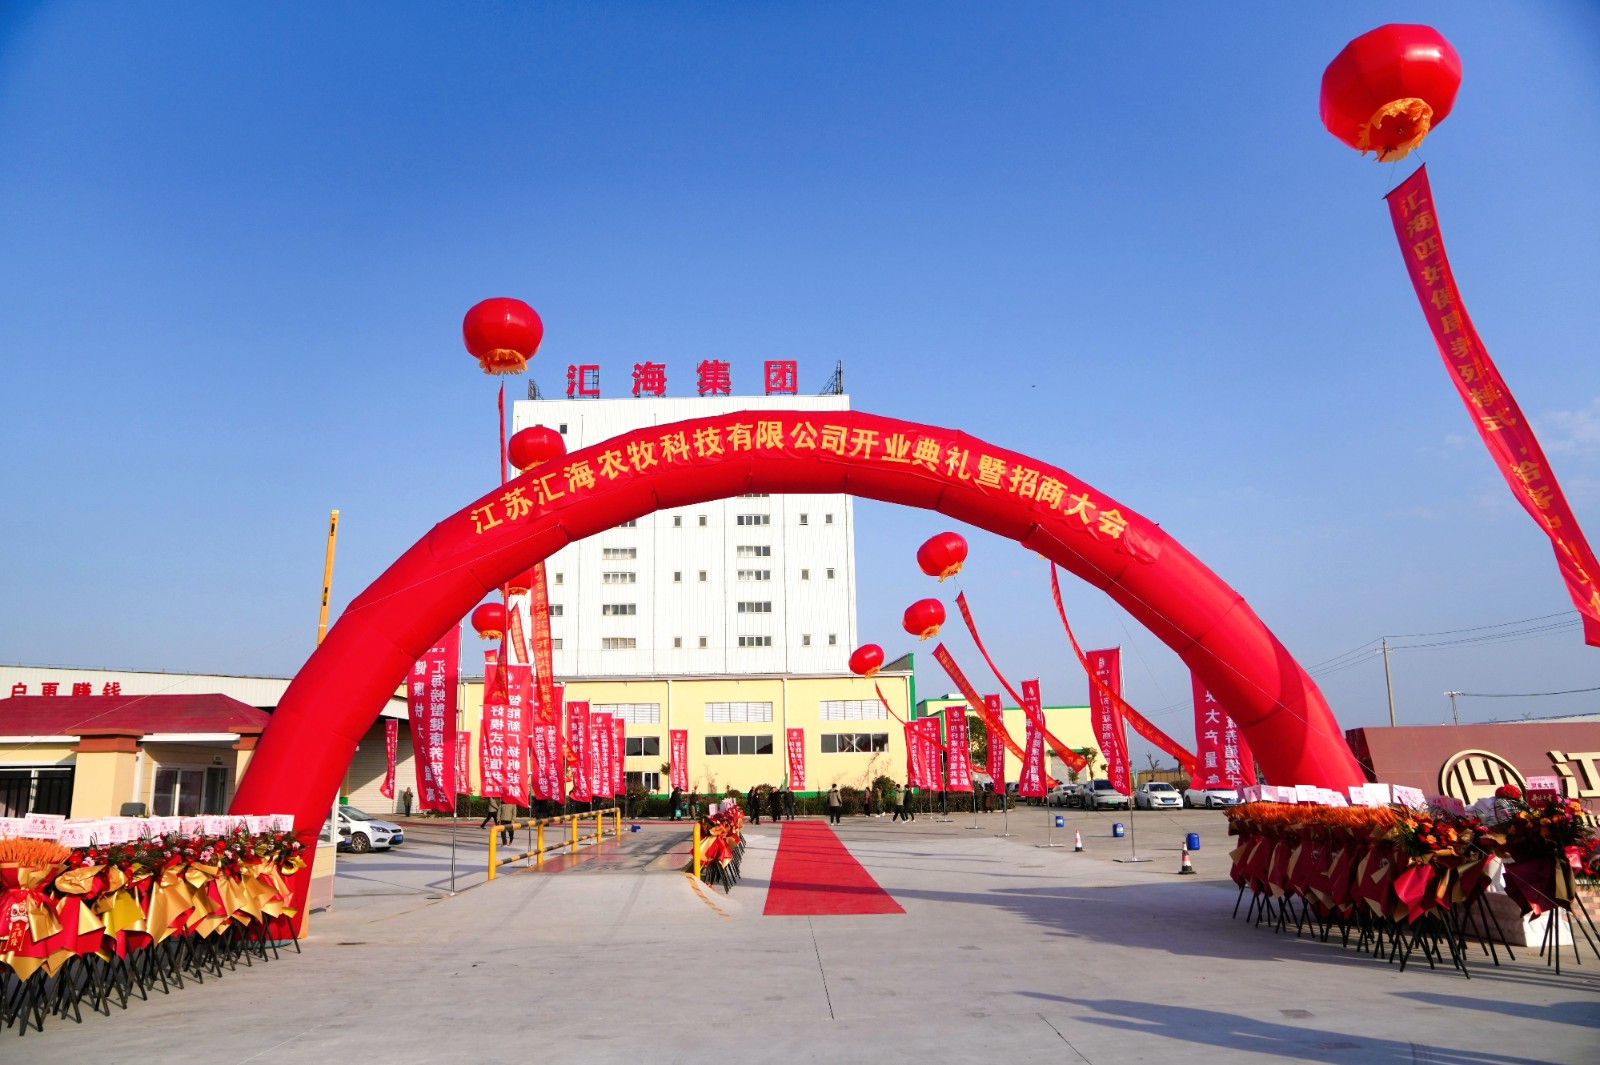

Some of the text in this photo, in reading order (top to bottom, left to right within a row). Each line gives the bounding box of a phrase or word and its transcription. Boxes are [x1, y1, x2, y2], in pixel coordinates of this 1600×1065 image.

[566, 360, 798, 395] 汇海集团
[469, 419, 1129, 540] 江苏汇海农牧科技有限公司开业典礼暨招商大会
